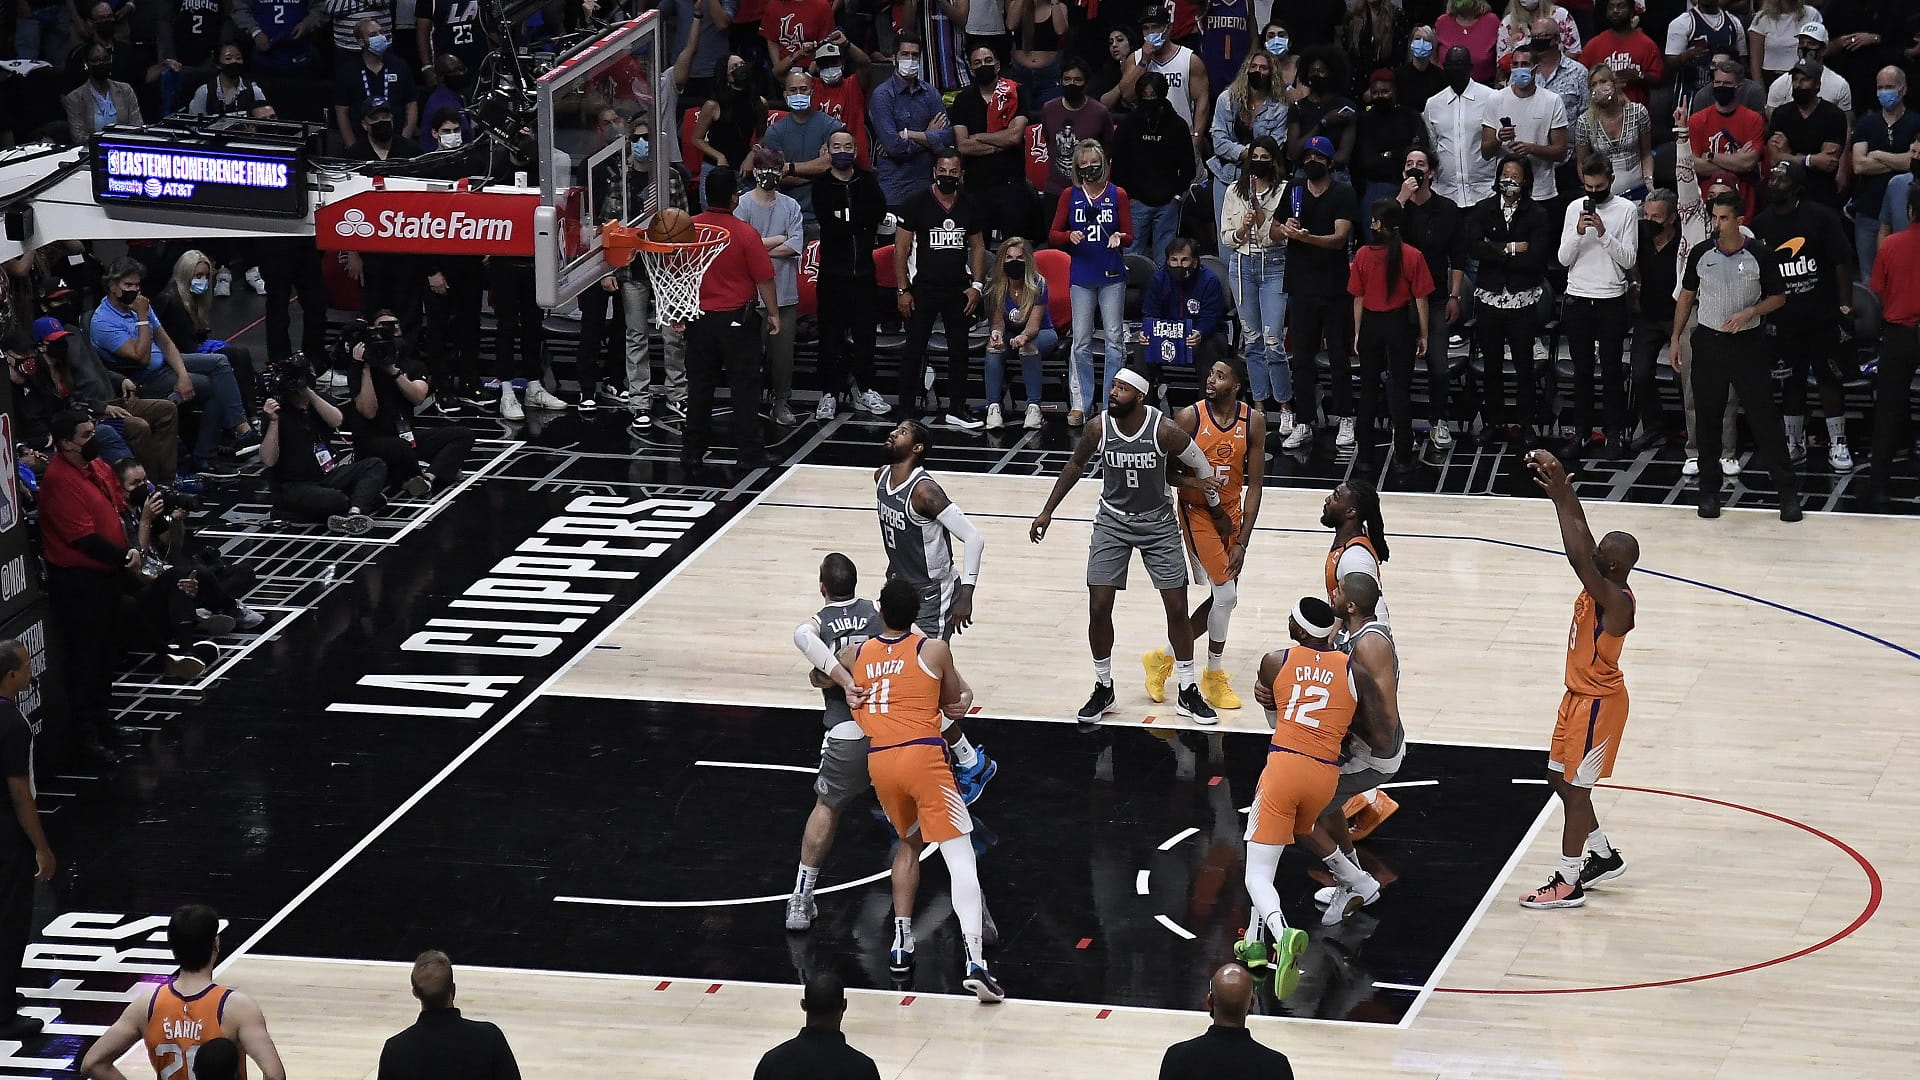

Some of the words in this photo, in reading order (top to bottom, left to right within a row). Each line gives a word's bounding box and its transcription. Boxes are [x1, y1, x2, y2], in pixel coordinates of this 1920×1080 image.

[192, 15, 203, 34] 2
[274, 5, 285, 24] 2
[1207, 15, 1248, 31] PHOENIX
[453, 24, 474, 45] 23
[1224, 34, 1232, 60] 1
[119, 151, 172, 179] EASTERN
[172, 155, 246, 185] CONFERENCE
[246, 161, 289, 188] FINALS
[162, 183, 195, 198] AT&T
[929, 231, 965, 246] CLIPPERS
[1086, 224, 1101, 242] 21
[1104, 451, 1157, 469] CLIPPERS
[1125, 469, 1139, 489] 8
[1, 554, 27, 601] @NBA
[399, 495, 717, 658] CLIPPERS
[827, 615, 868, 634] ZUBAC
[865, 659, 906, 680] NADER
[1295, 665, 1334, 686] CRAIG
[325, 674, 525, 719] LA
[867, 678, 891, 714] 11
[1283, 683, 1331, 729] 12
[162, 1017, 204, 1041] ŠARIĆ
